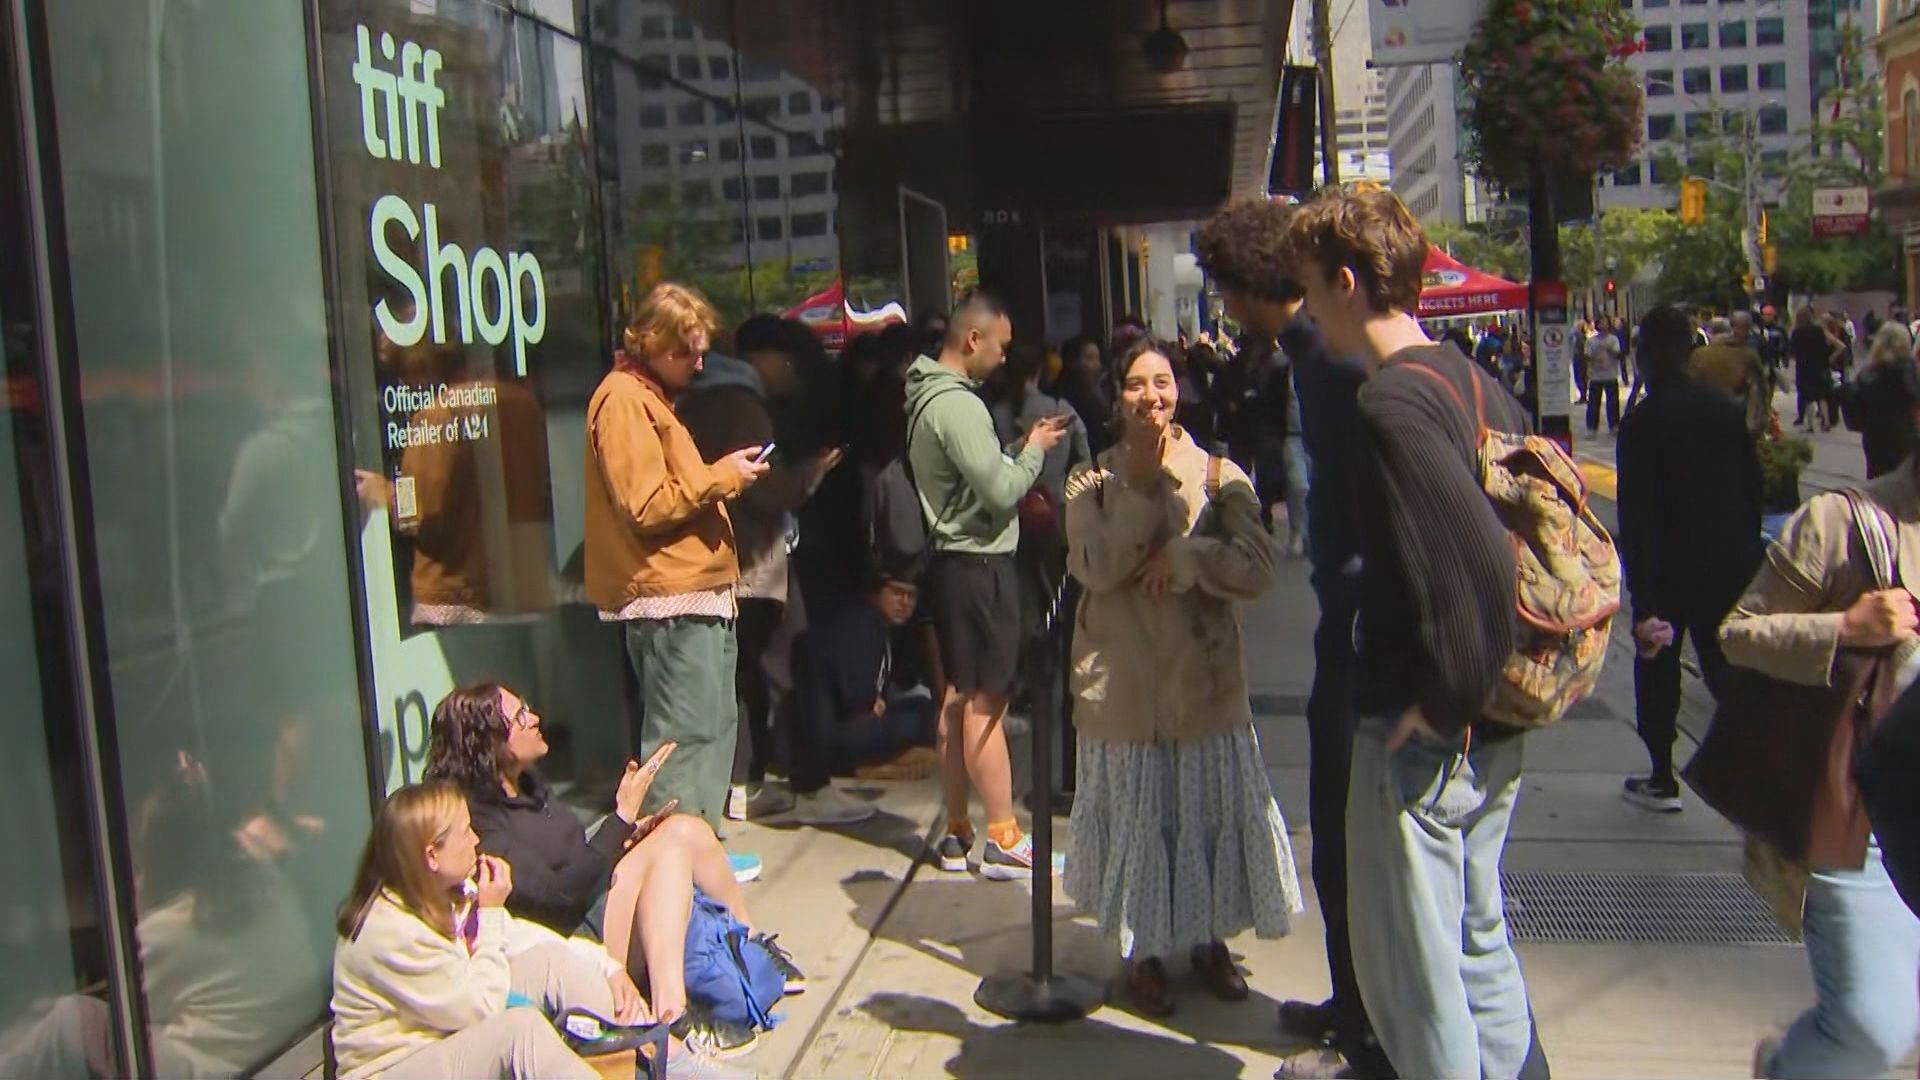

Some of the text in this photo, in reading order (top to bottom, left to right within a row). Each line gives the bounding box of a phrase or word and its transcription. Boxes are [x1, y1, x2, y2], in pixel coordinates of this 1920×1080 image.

[353, 24, 445, 168] tiff
[370, 194, 546, 376] Shop
[1467, 293, 1499, 305] HERE
[384, 381, 497, 413] Official Canadian
[387, 413, 489, 450] Retailer of A24
